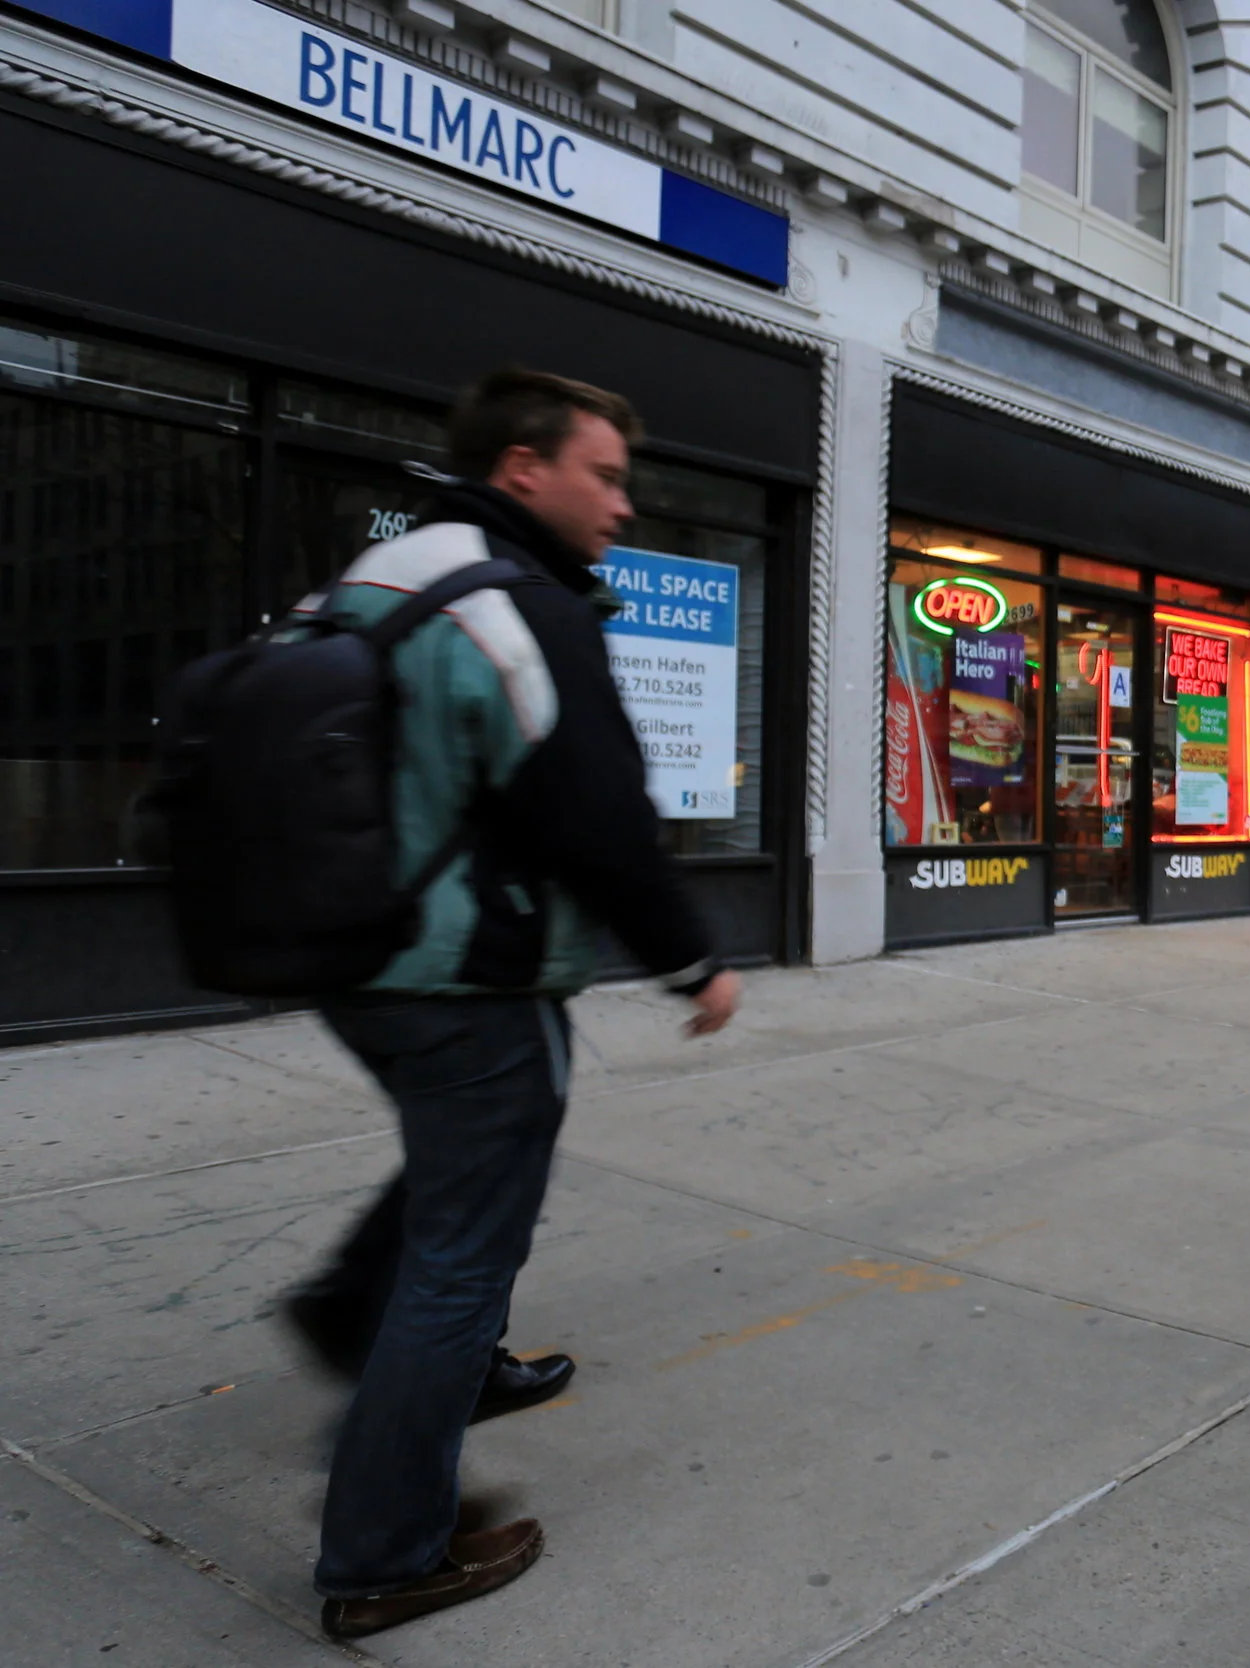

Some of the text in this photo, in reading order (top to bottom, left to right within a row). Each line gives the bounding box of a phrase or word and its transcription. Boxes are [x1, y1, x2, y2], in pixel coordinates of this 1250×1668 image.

[301, 30, 577, 199] BELLMARC
[367, 508, 418, 541] 269
[588, 564, 729, 604] TAIL SPACE
[645, 603, 712, 632] LEASE
[926, 587, 994, 624] OPEN
[1006, 602, 1034, 621] 699
[955, 637, 1007, 662] Italian
[1172, 632, 1227, 663] WE BAKE
[610, 655, 705, 674] nsen Hafen
[955, 658, 995, 679] Hero
[1168, 654, 1228, 684] OUR OWN
[618, 675, 702, 696] 2.710.5245
[1113, 671, 1126, 696] A
[1177, 677, 1220, 697] BREAD
[636, 719, 694, 736] Gilbert
[642, 742, 702, 759] 10.5242
[909, 856, 1029, 889] SUBWAY
[1165, 853, 1246, 879] SUBWAY
